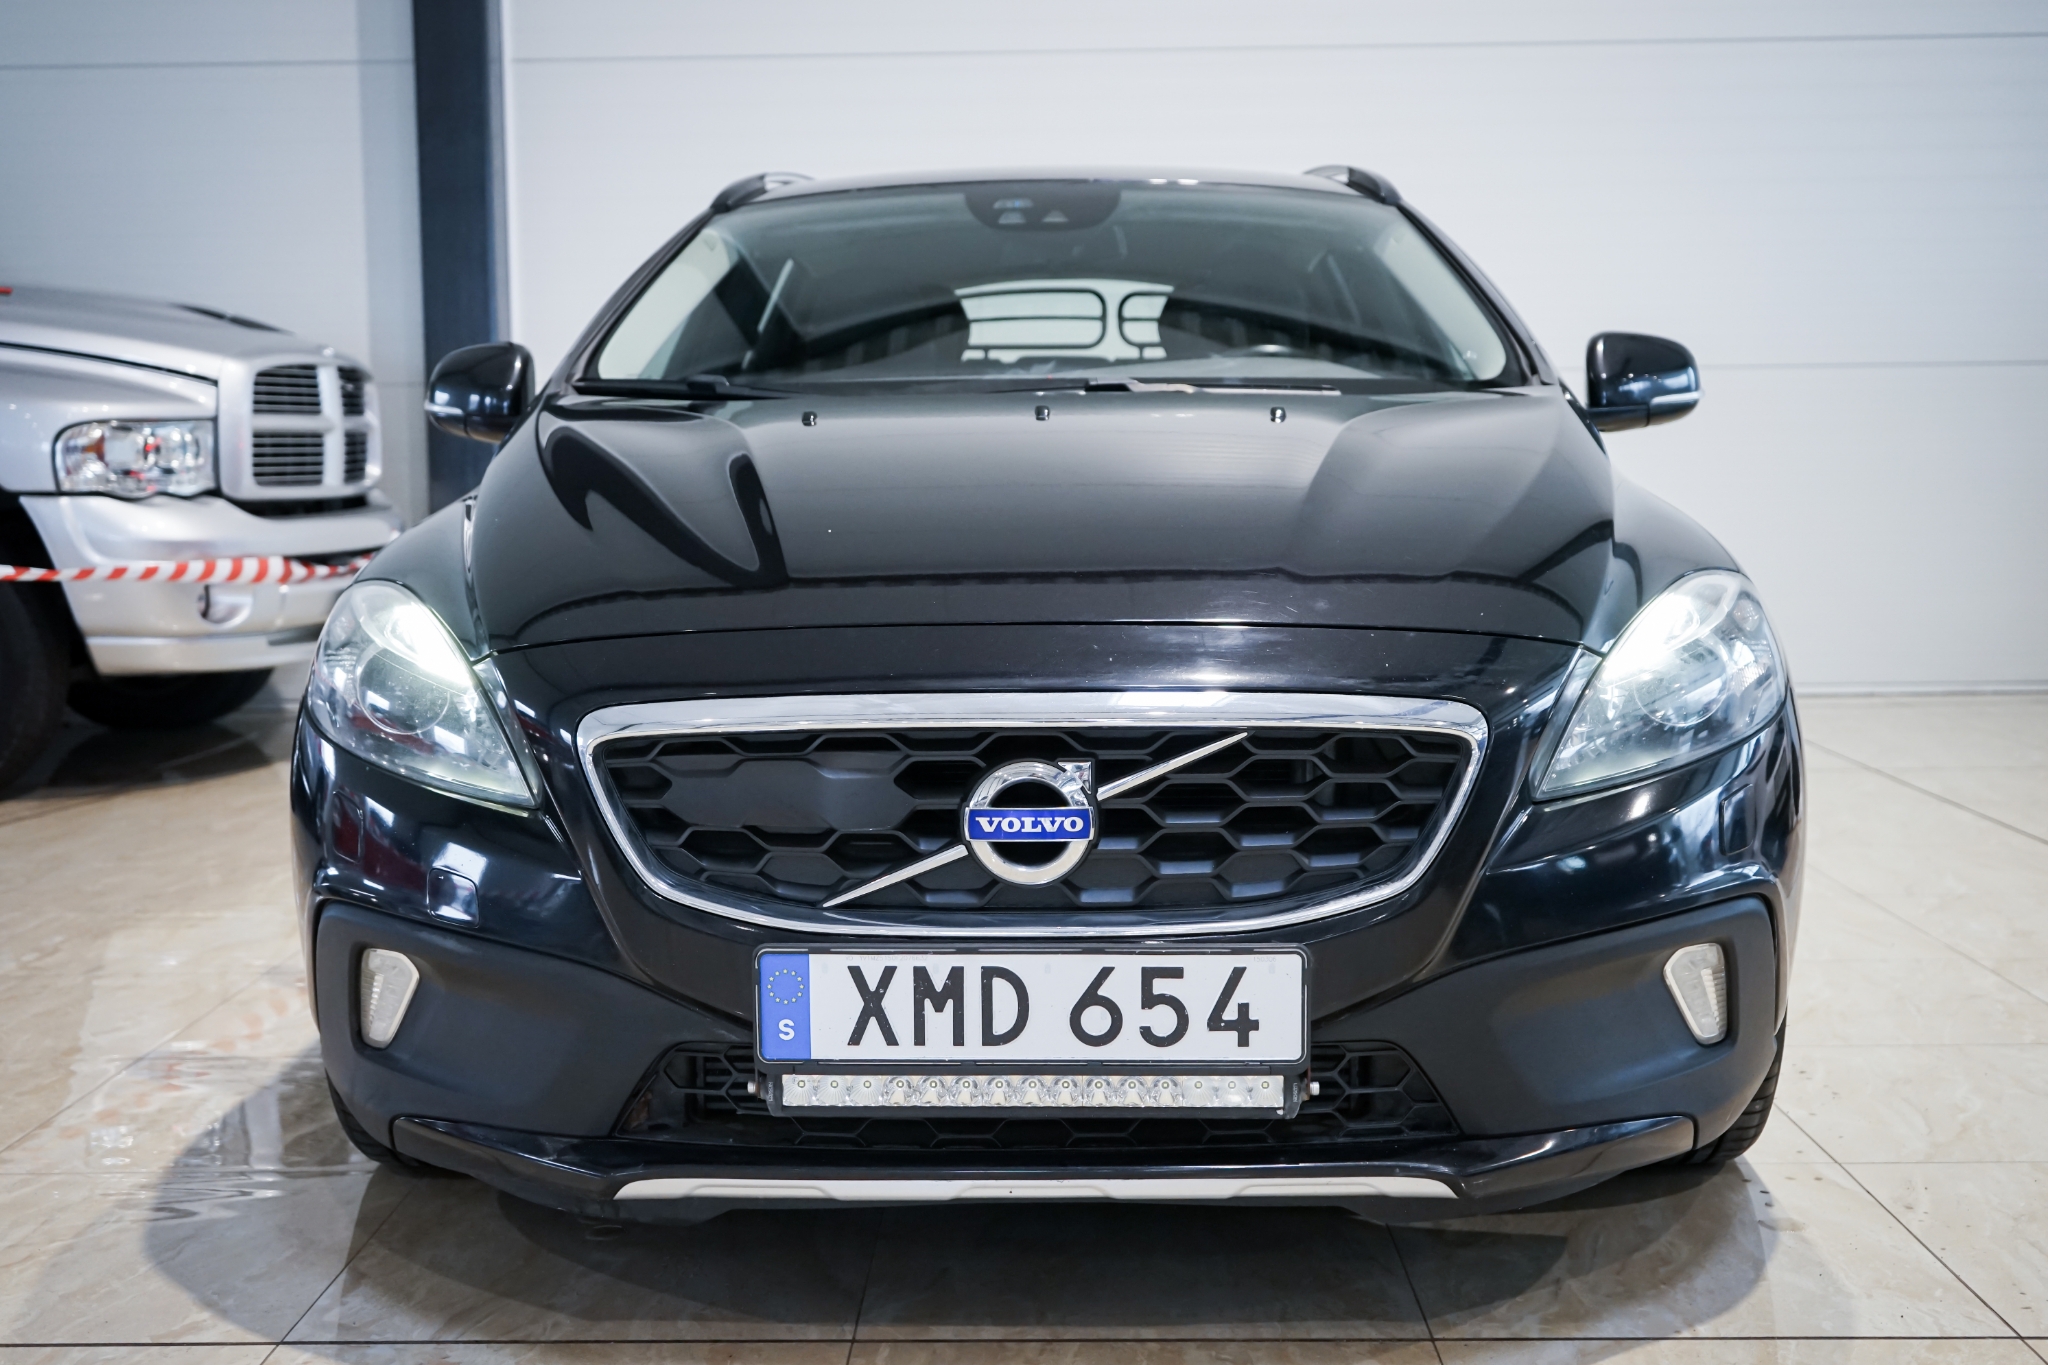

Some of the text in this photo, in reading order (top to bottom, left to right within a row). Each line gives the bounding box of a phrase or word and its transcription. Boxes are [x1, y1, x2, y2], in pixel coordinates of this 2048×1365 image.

[975, 816, 1084, 833] VOLVO
[847, 966, 1260, 1048] XMD 654
[778, 1018, 795, 1041] S
